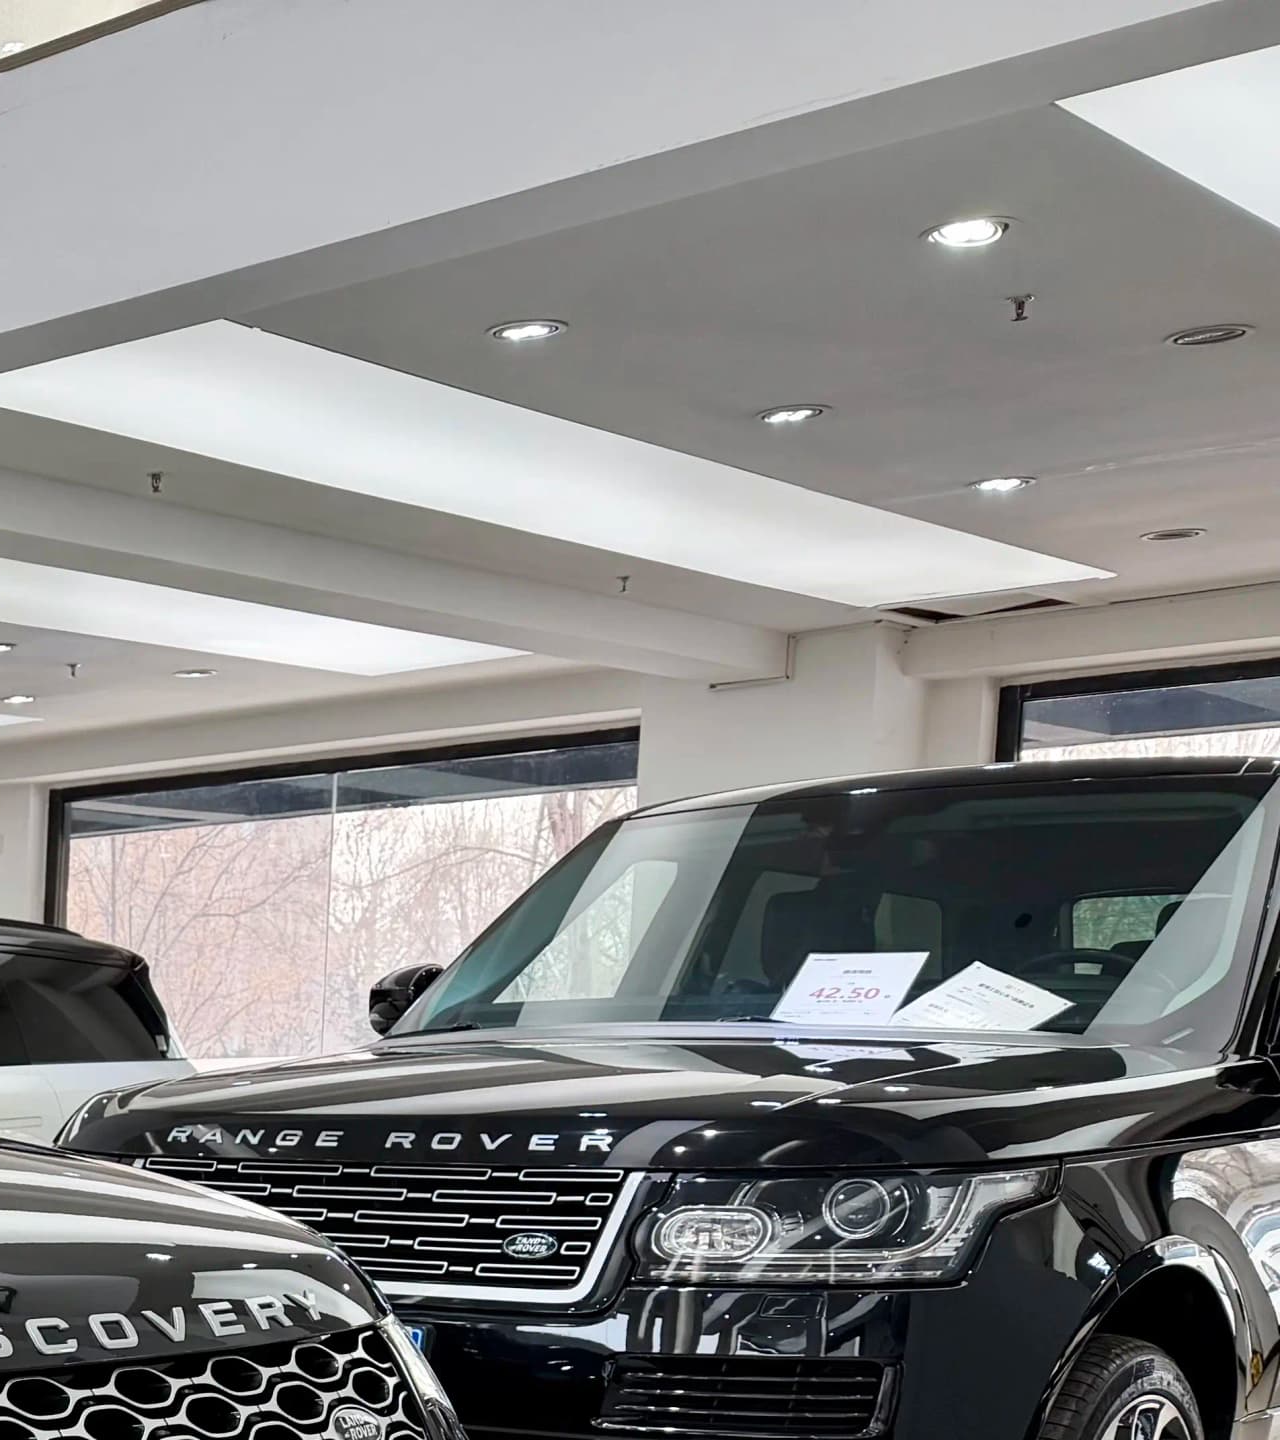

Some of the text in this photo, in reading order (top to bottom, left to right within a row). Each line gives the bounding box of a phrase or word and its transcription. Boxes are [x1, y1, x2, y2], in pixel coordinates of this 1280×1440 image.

[809, 986, 881, 1000] 42.50
[167, 1125, 614, 1152] RANGE ROVER
[515, 1236, 542, 1245] LAND
[516, 1244, 548, 1252] ROVER
[349, 1424, 378, 1440] ROVER
